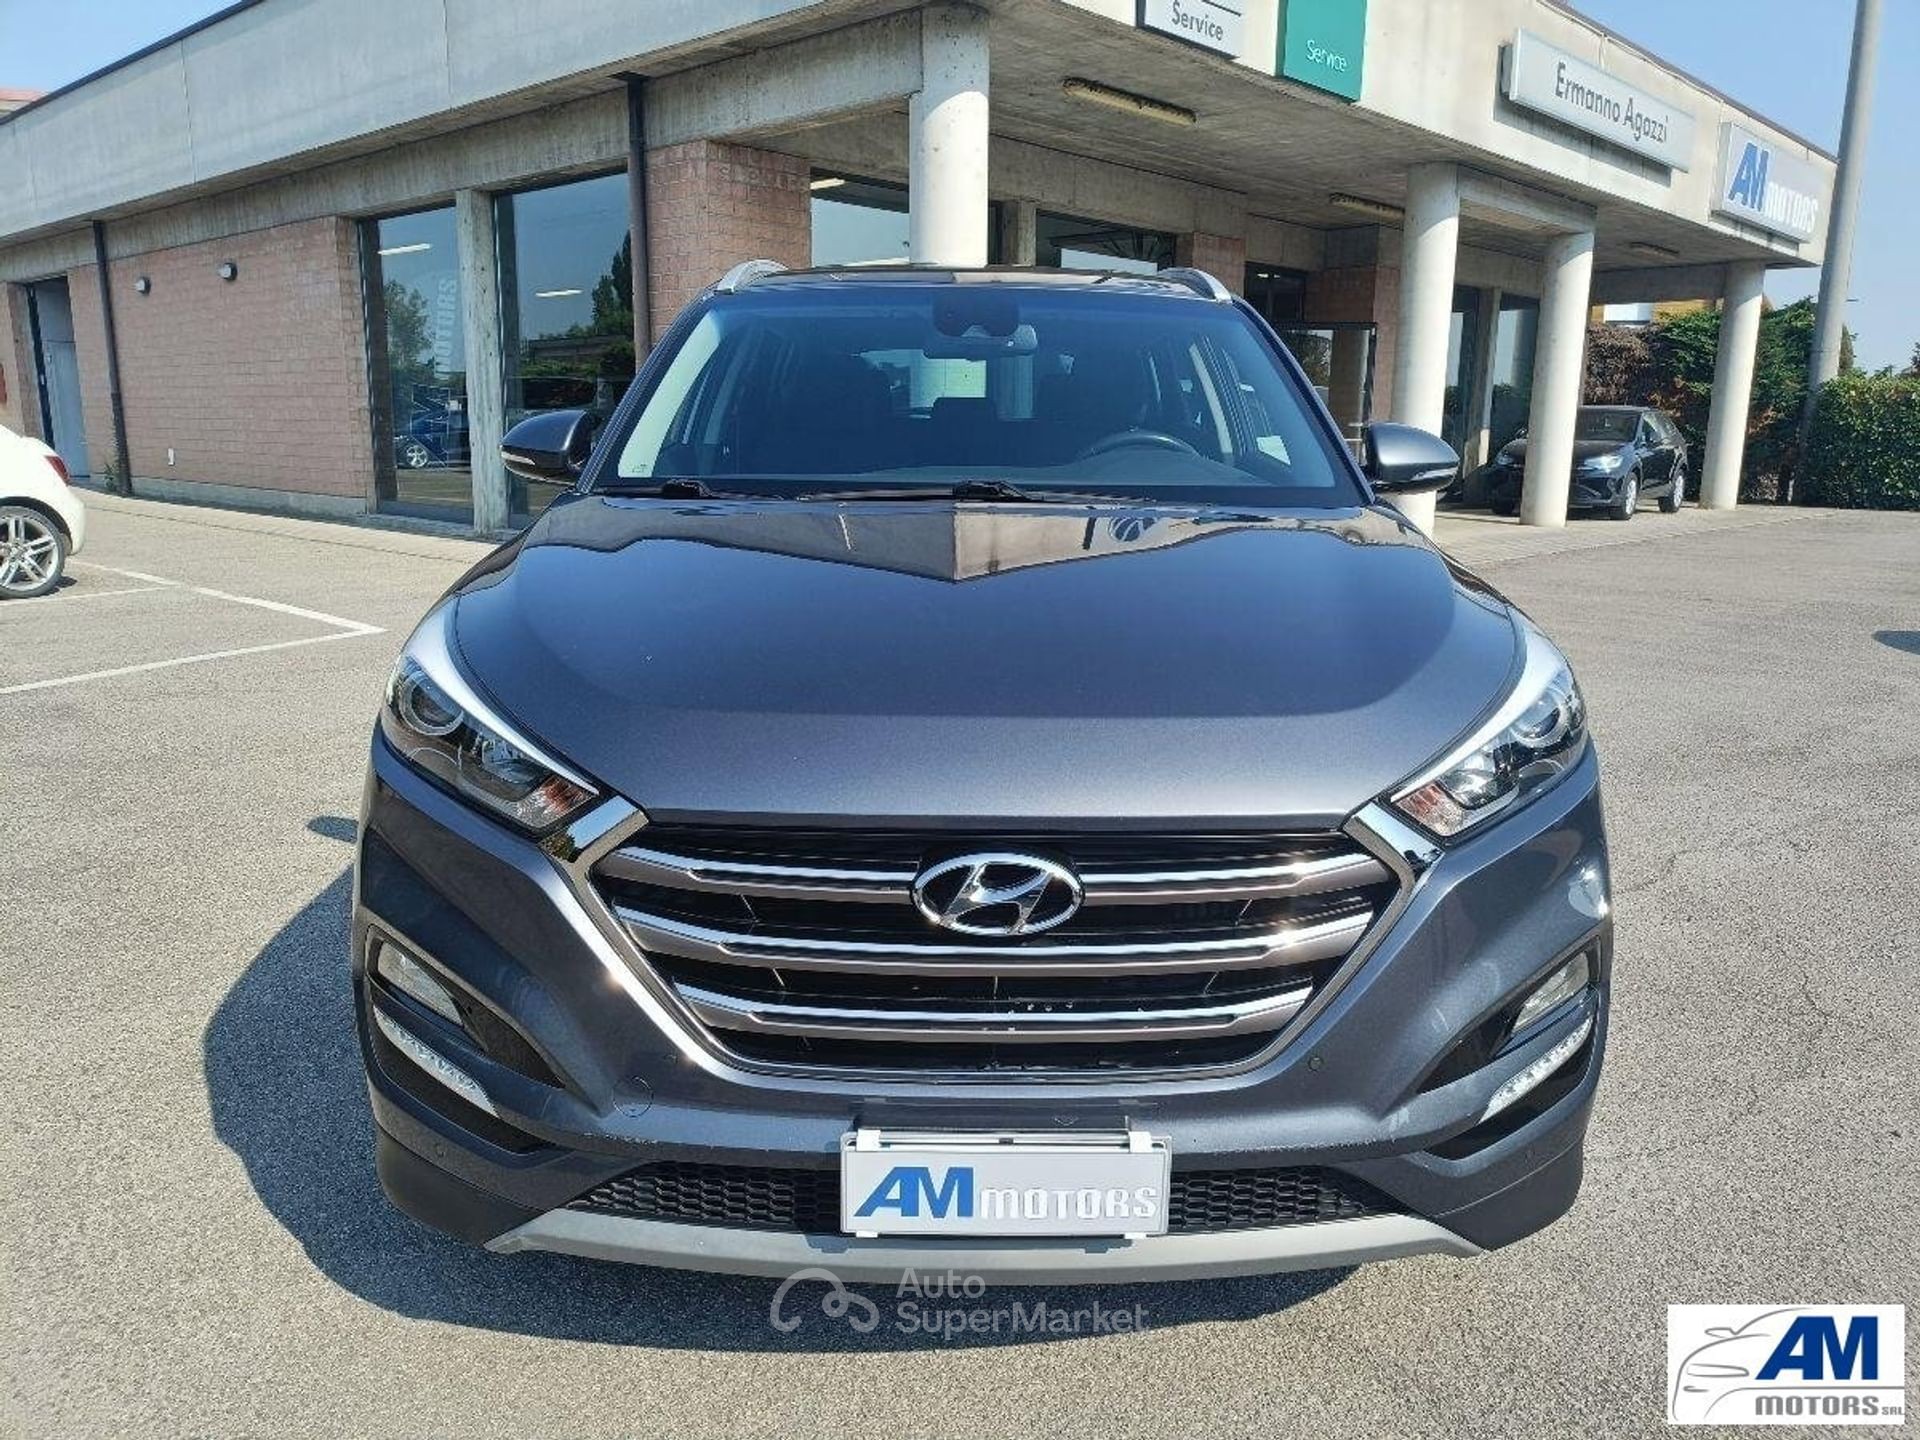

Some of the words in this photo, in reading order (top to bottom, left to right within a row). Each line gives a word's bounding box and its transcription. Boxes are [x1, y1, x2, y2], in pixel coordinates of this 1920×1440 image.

[1171, 1, 1224, 41] Service
[1306, 39, 1348, 73] Service
[1555, 61, 1621, 123] Ermanno
[1728, 142, 1769, 212] AM
[854, 1166, 974, 1218] AM
